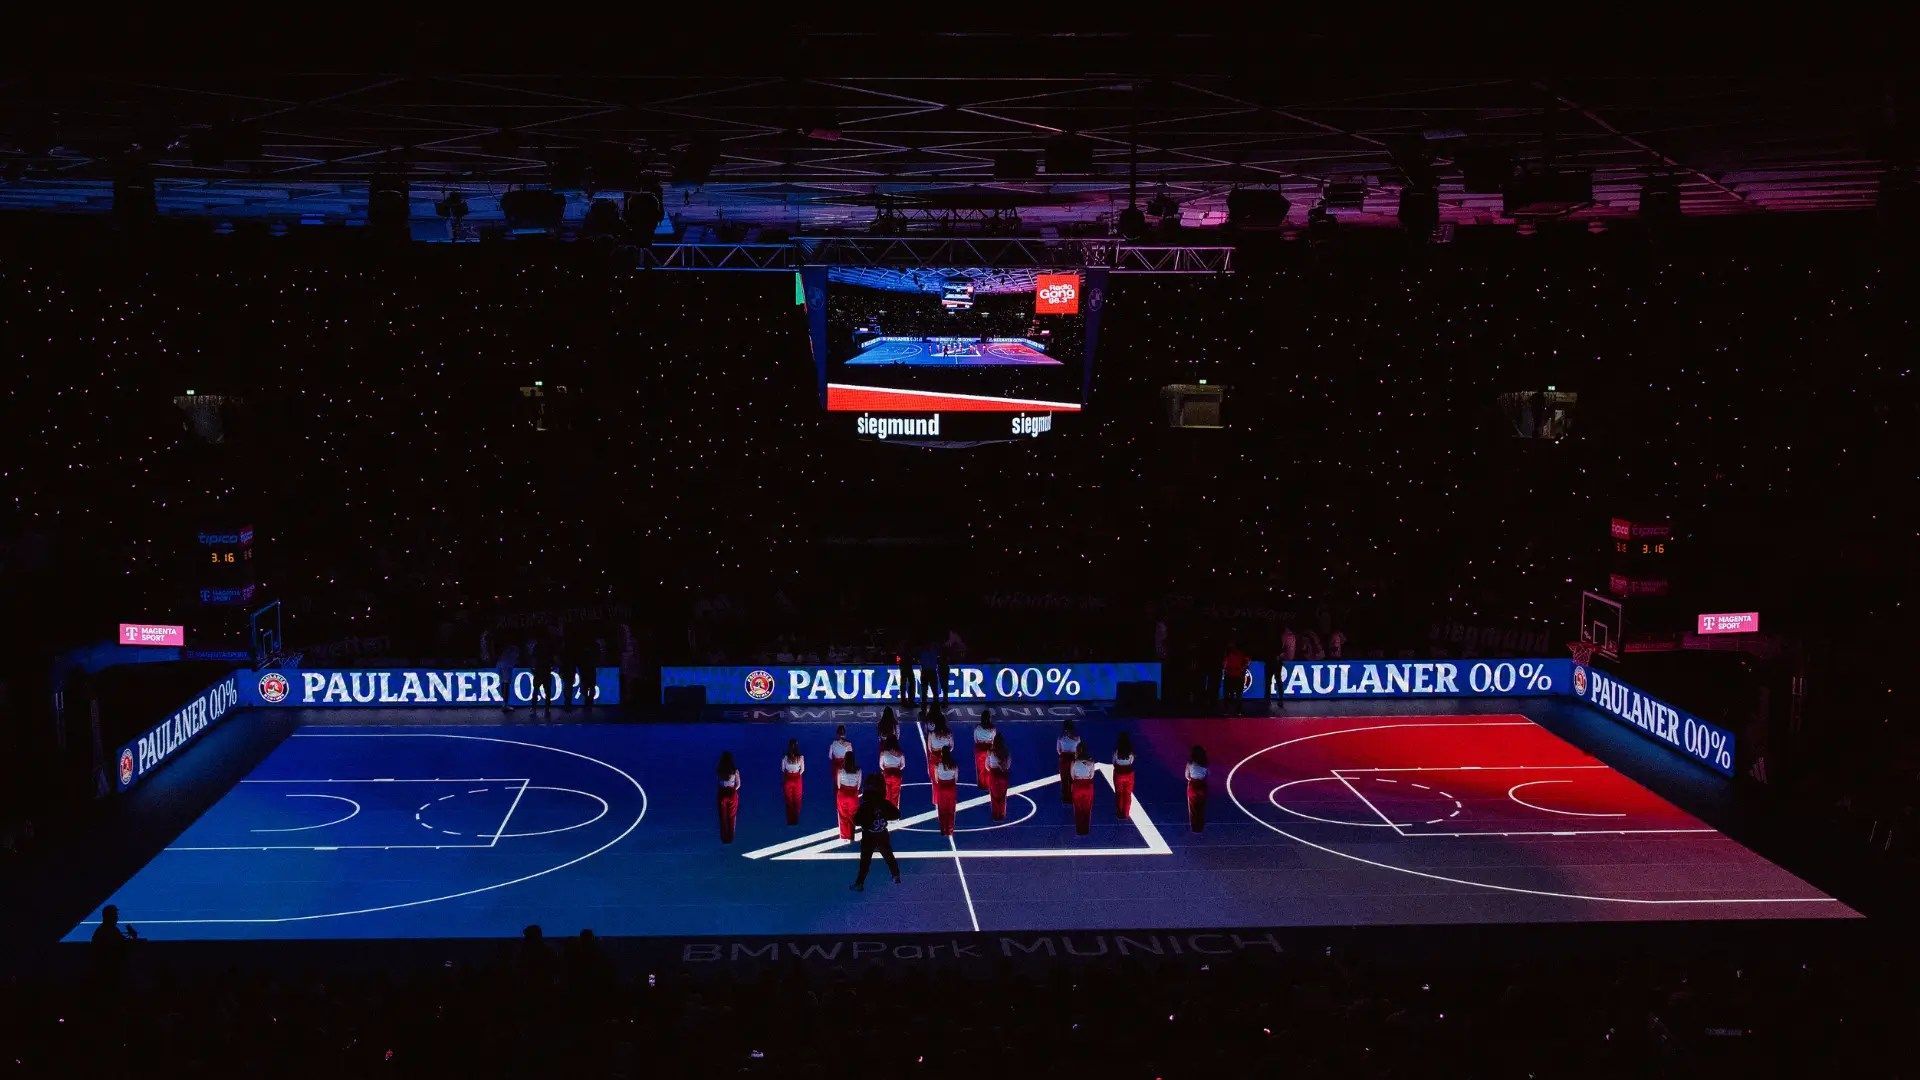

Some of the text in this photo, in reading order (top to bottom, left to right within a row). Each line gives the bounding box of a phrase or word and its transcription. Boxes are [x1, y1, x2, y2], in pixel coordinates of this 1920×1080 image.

[857, 413, 940, 440] siegmund
[141, 627, 177, 635] MAGENTA
[1718, 615, 1752, 623] MAGENTA
[1718, 622, 1741, 630] SPORT
[301, 672, 504, 702] PAULANER
[995, 668, 1080, 699] 0,0%
[1469, 661, 1552, 693] 0,0%
[1591, 671, 1680, 747] PAULANER
[138, 696, 208, 775] PAULANER
[681, 933, 1286, 963] BMWPark MUNICH
